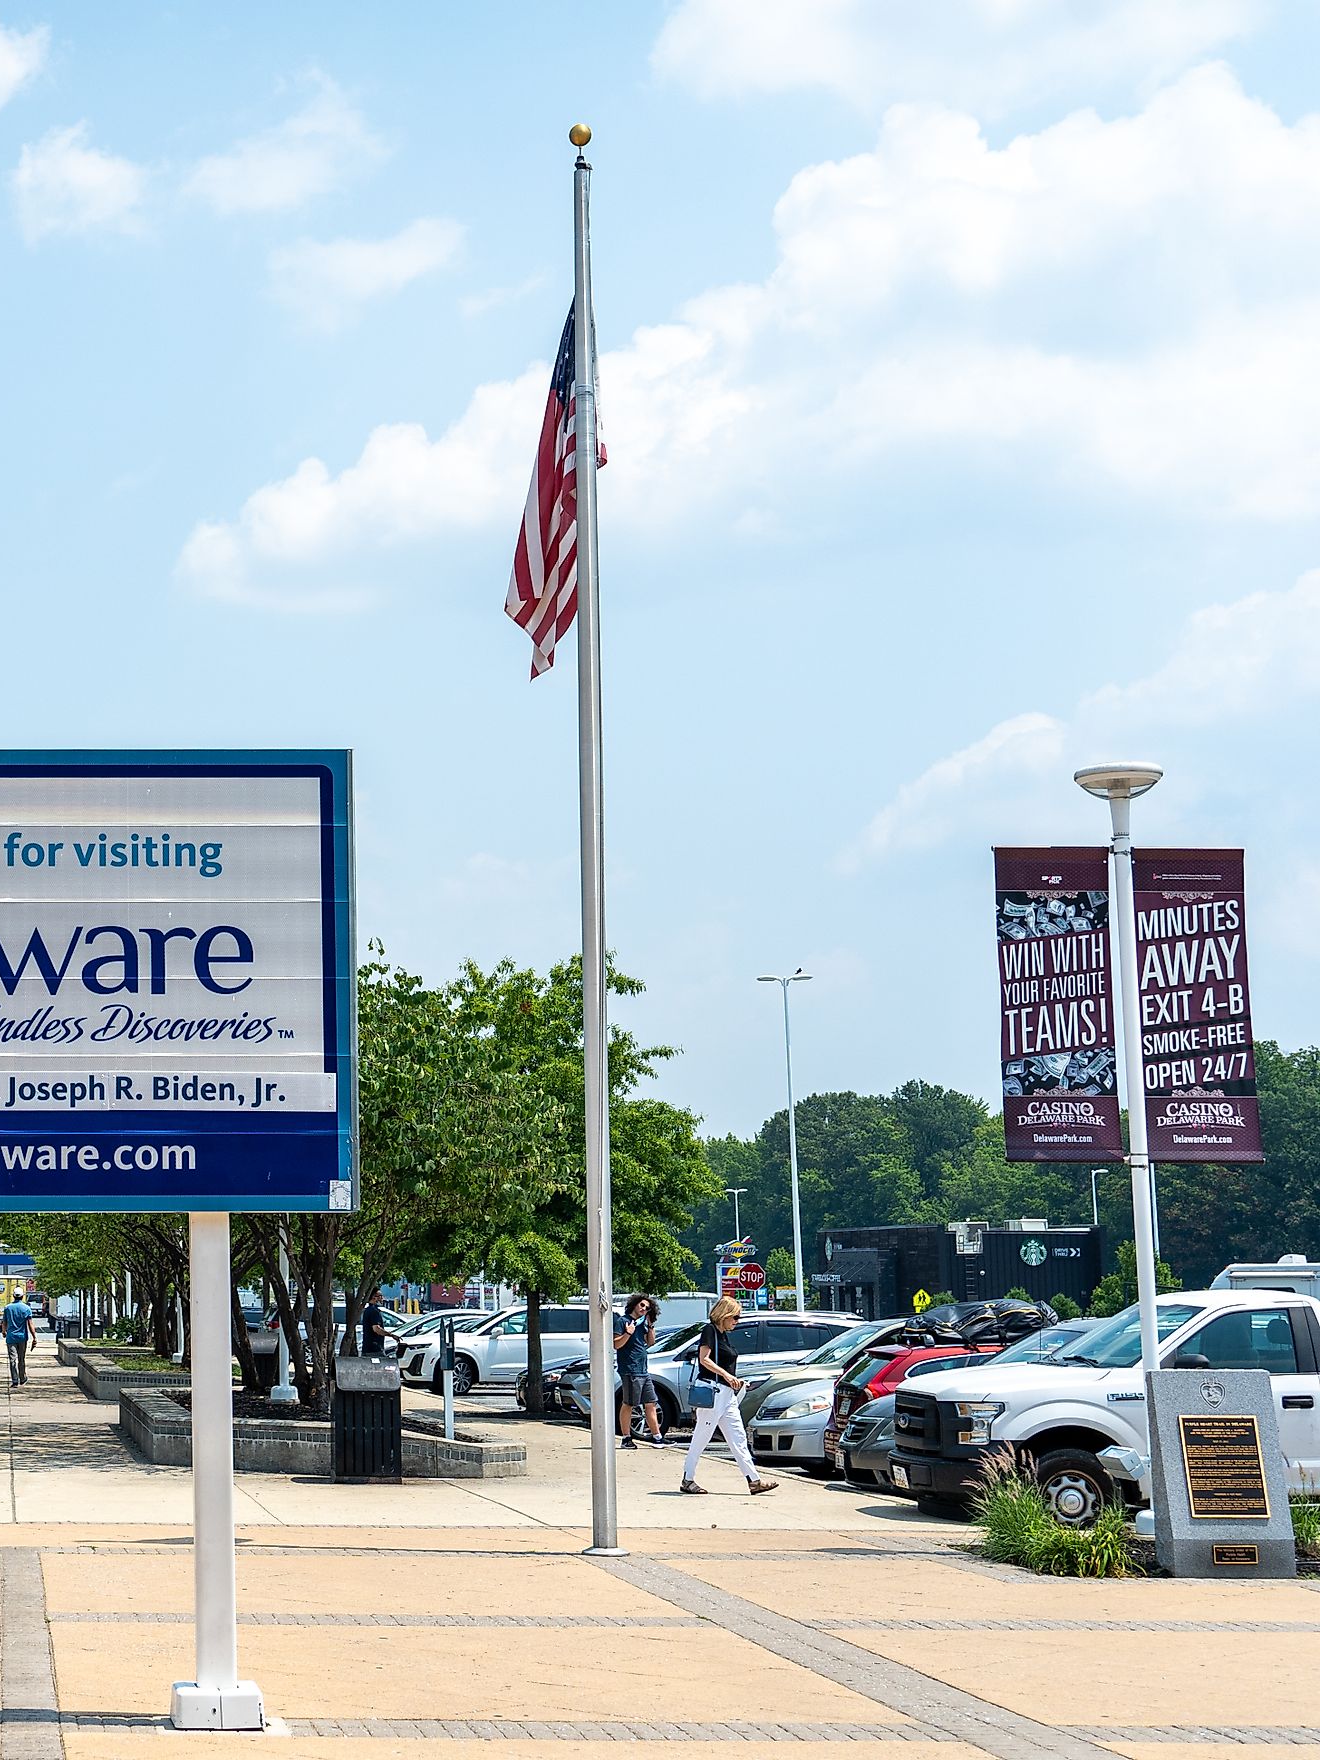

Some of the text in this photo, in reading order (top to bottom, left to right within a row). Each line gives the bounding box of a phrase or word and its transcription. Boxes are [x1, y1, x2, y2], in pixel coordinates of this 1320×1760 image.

[4, 832, 65, 868] for
[73, 833, 223, 878] visiting
[1138, 900, 1240, 941] MINUTES
[1002, 933, 1106, 981] WIN WITH
[1140, 935, 1240, 991] AWAY
[1003, 971, 1106, 1006] YOUR FAVORITE
[1142, 984, 1244, 1027] EXIT 4-B
[90, 1004, 278, 1044] Discoveries
[1004, 998, 1108, 1056] TEAMS!
[1143, 1022, 1246, 1056] SMOKE-FREE
[1145, 1052, 1248, 1090] OPEN 24/7
[6, 1076, 105, 1108] Joseph
[115, 1076, 142, 1101] R.
[153, 1076, 244, 1106] Biden,
[252, 1077, 286, 1108] Jr.
[1027, 1102, 1094, 1116] CASINO
[1166, 1102, 1234, 1116] CASINO
[1017, 1114, 1106, 1126] DELAWARE PARK
[1156, 1116, 1246, 1128] DELAWARE PARK
[1034, 1134, 1092, 1143] DelawarePark.com
[1173, 1134, 1233, 1144] DelawarePark.com
[740, 1271, 764, 1282] STOP
